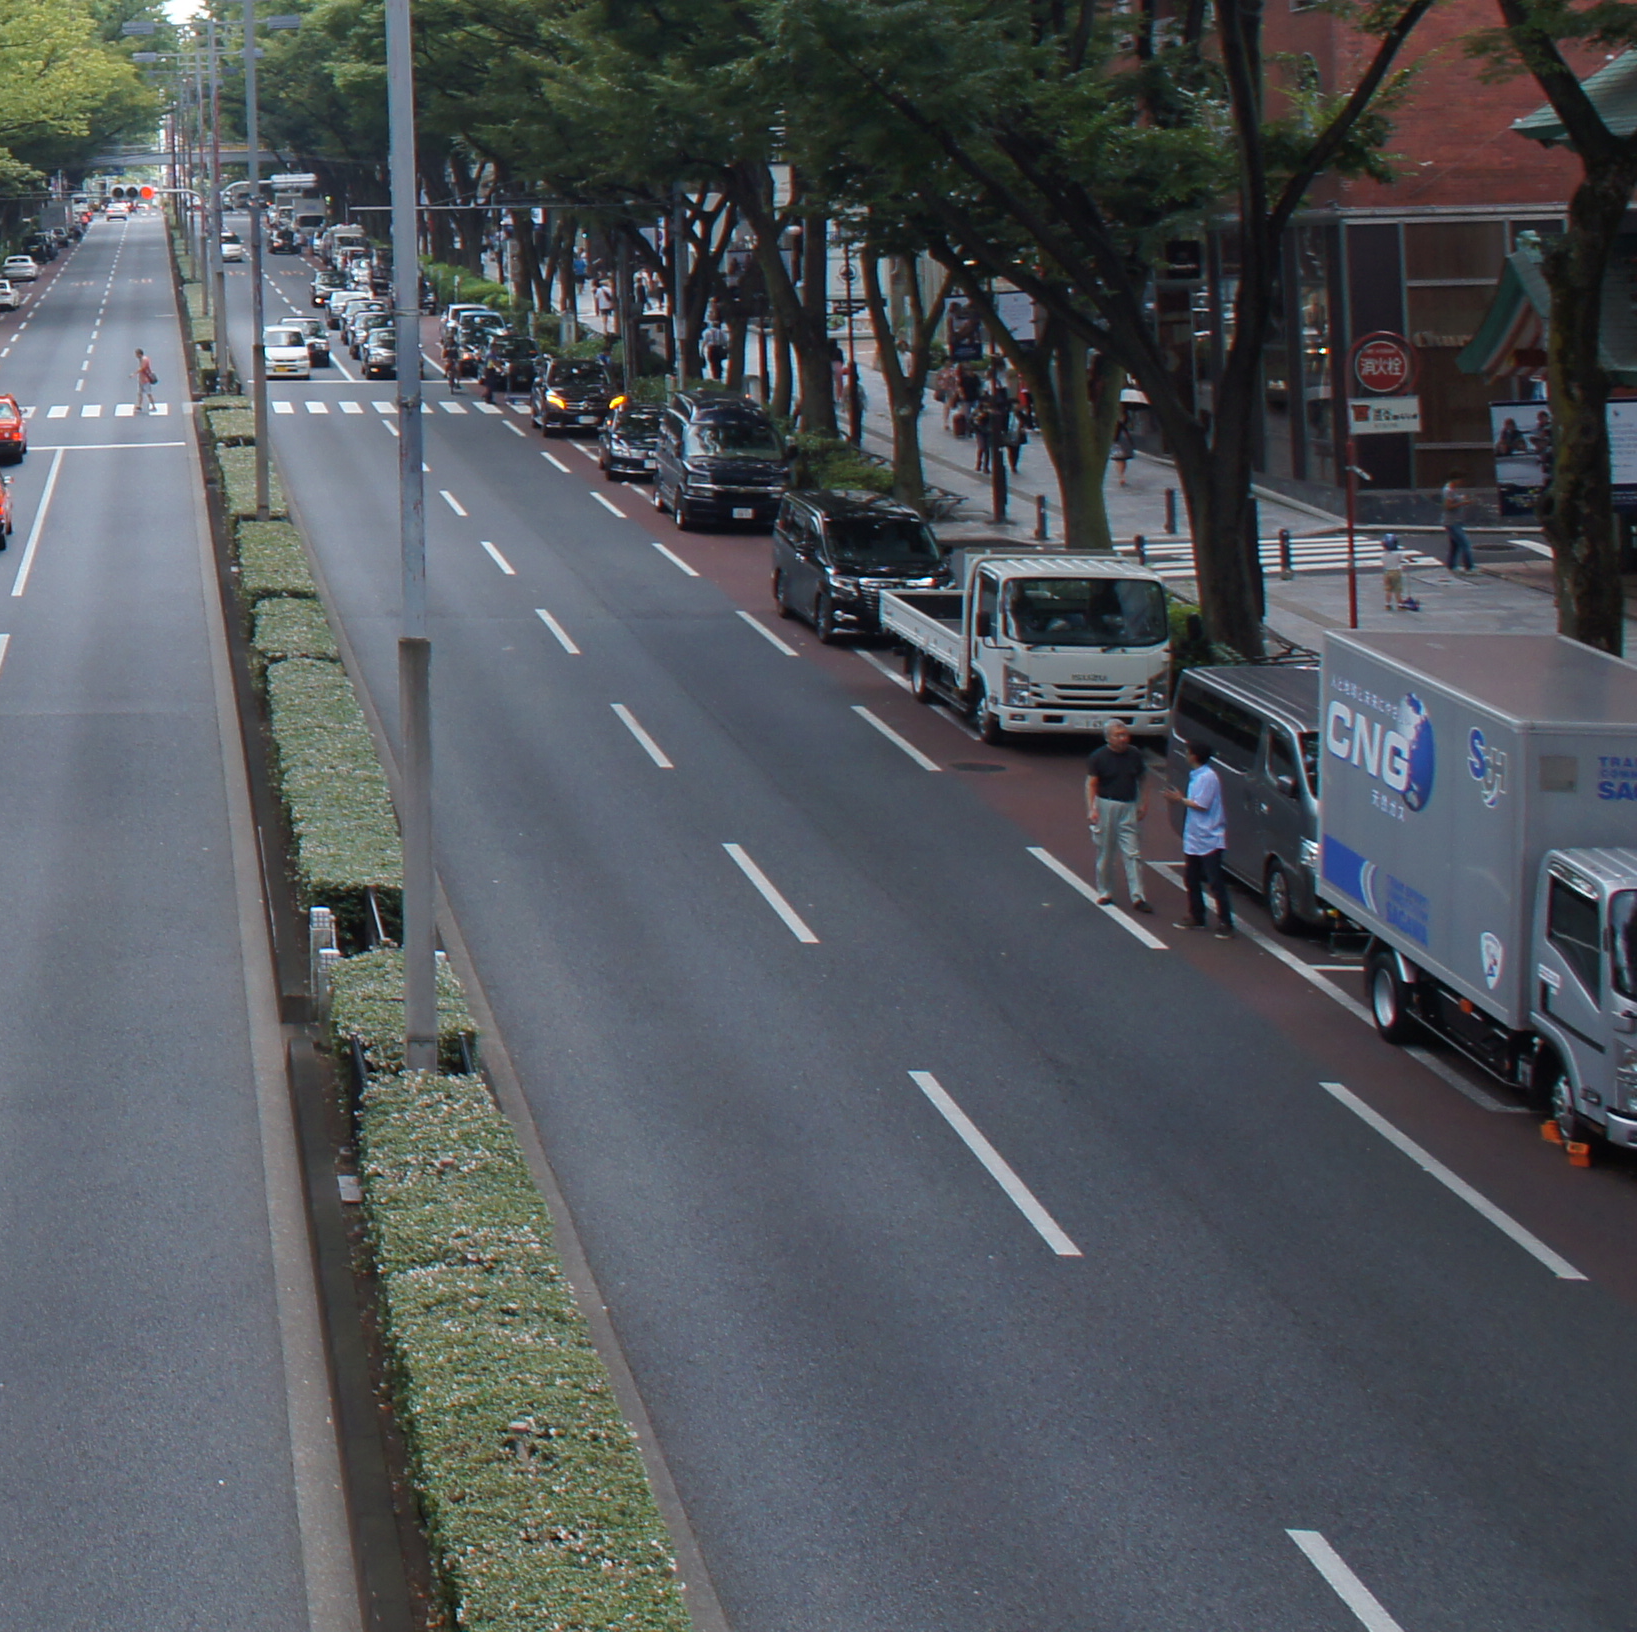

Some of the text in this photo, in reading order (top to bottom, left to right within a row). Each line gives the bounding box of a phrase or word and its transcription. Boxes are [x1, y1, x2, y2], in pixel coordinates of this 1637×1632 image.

[1361, 357, 1402, 375] 消火栓
[1327, 700, 1411, 793] CNG
